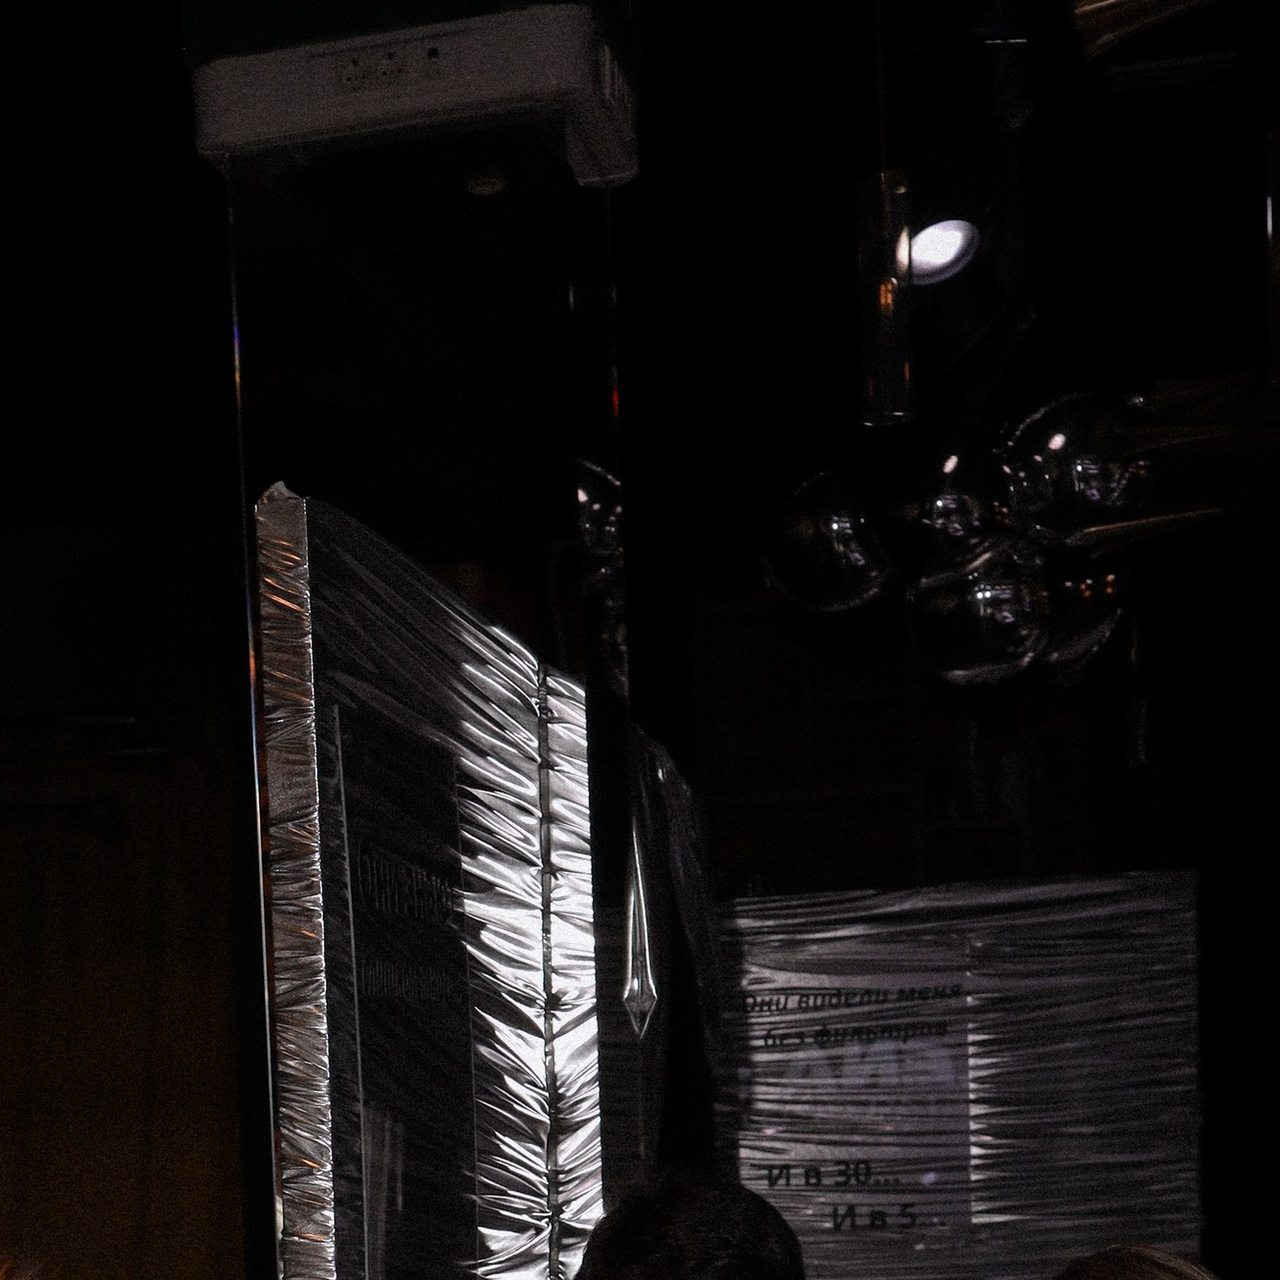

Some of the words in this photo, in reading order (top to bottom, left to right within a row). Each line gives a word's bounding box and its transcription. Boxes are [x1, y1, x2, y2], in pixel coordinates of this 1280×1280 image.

[797, 988, 889, 1010] видели
[767, 1165, 791, 1188] И
[805, 1166, 822, 1187] в
[832, 1203, 856, 1231] И
[869, 1207, 888, 1230] в
